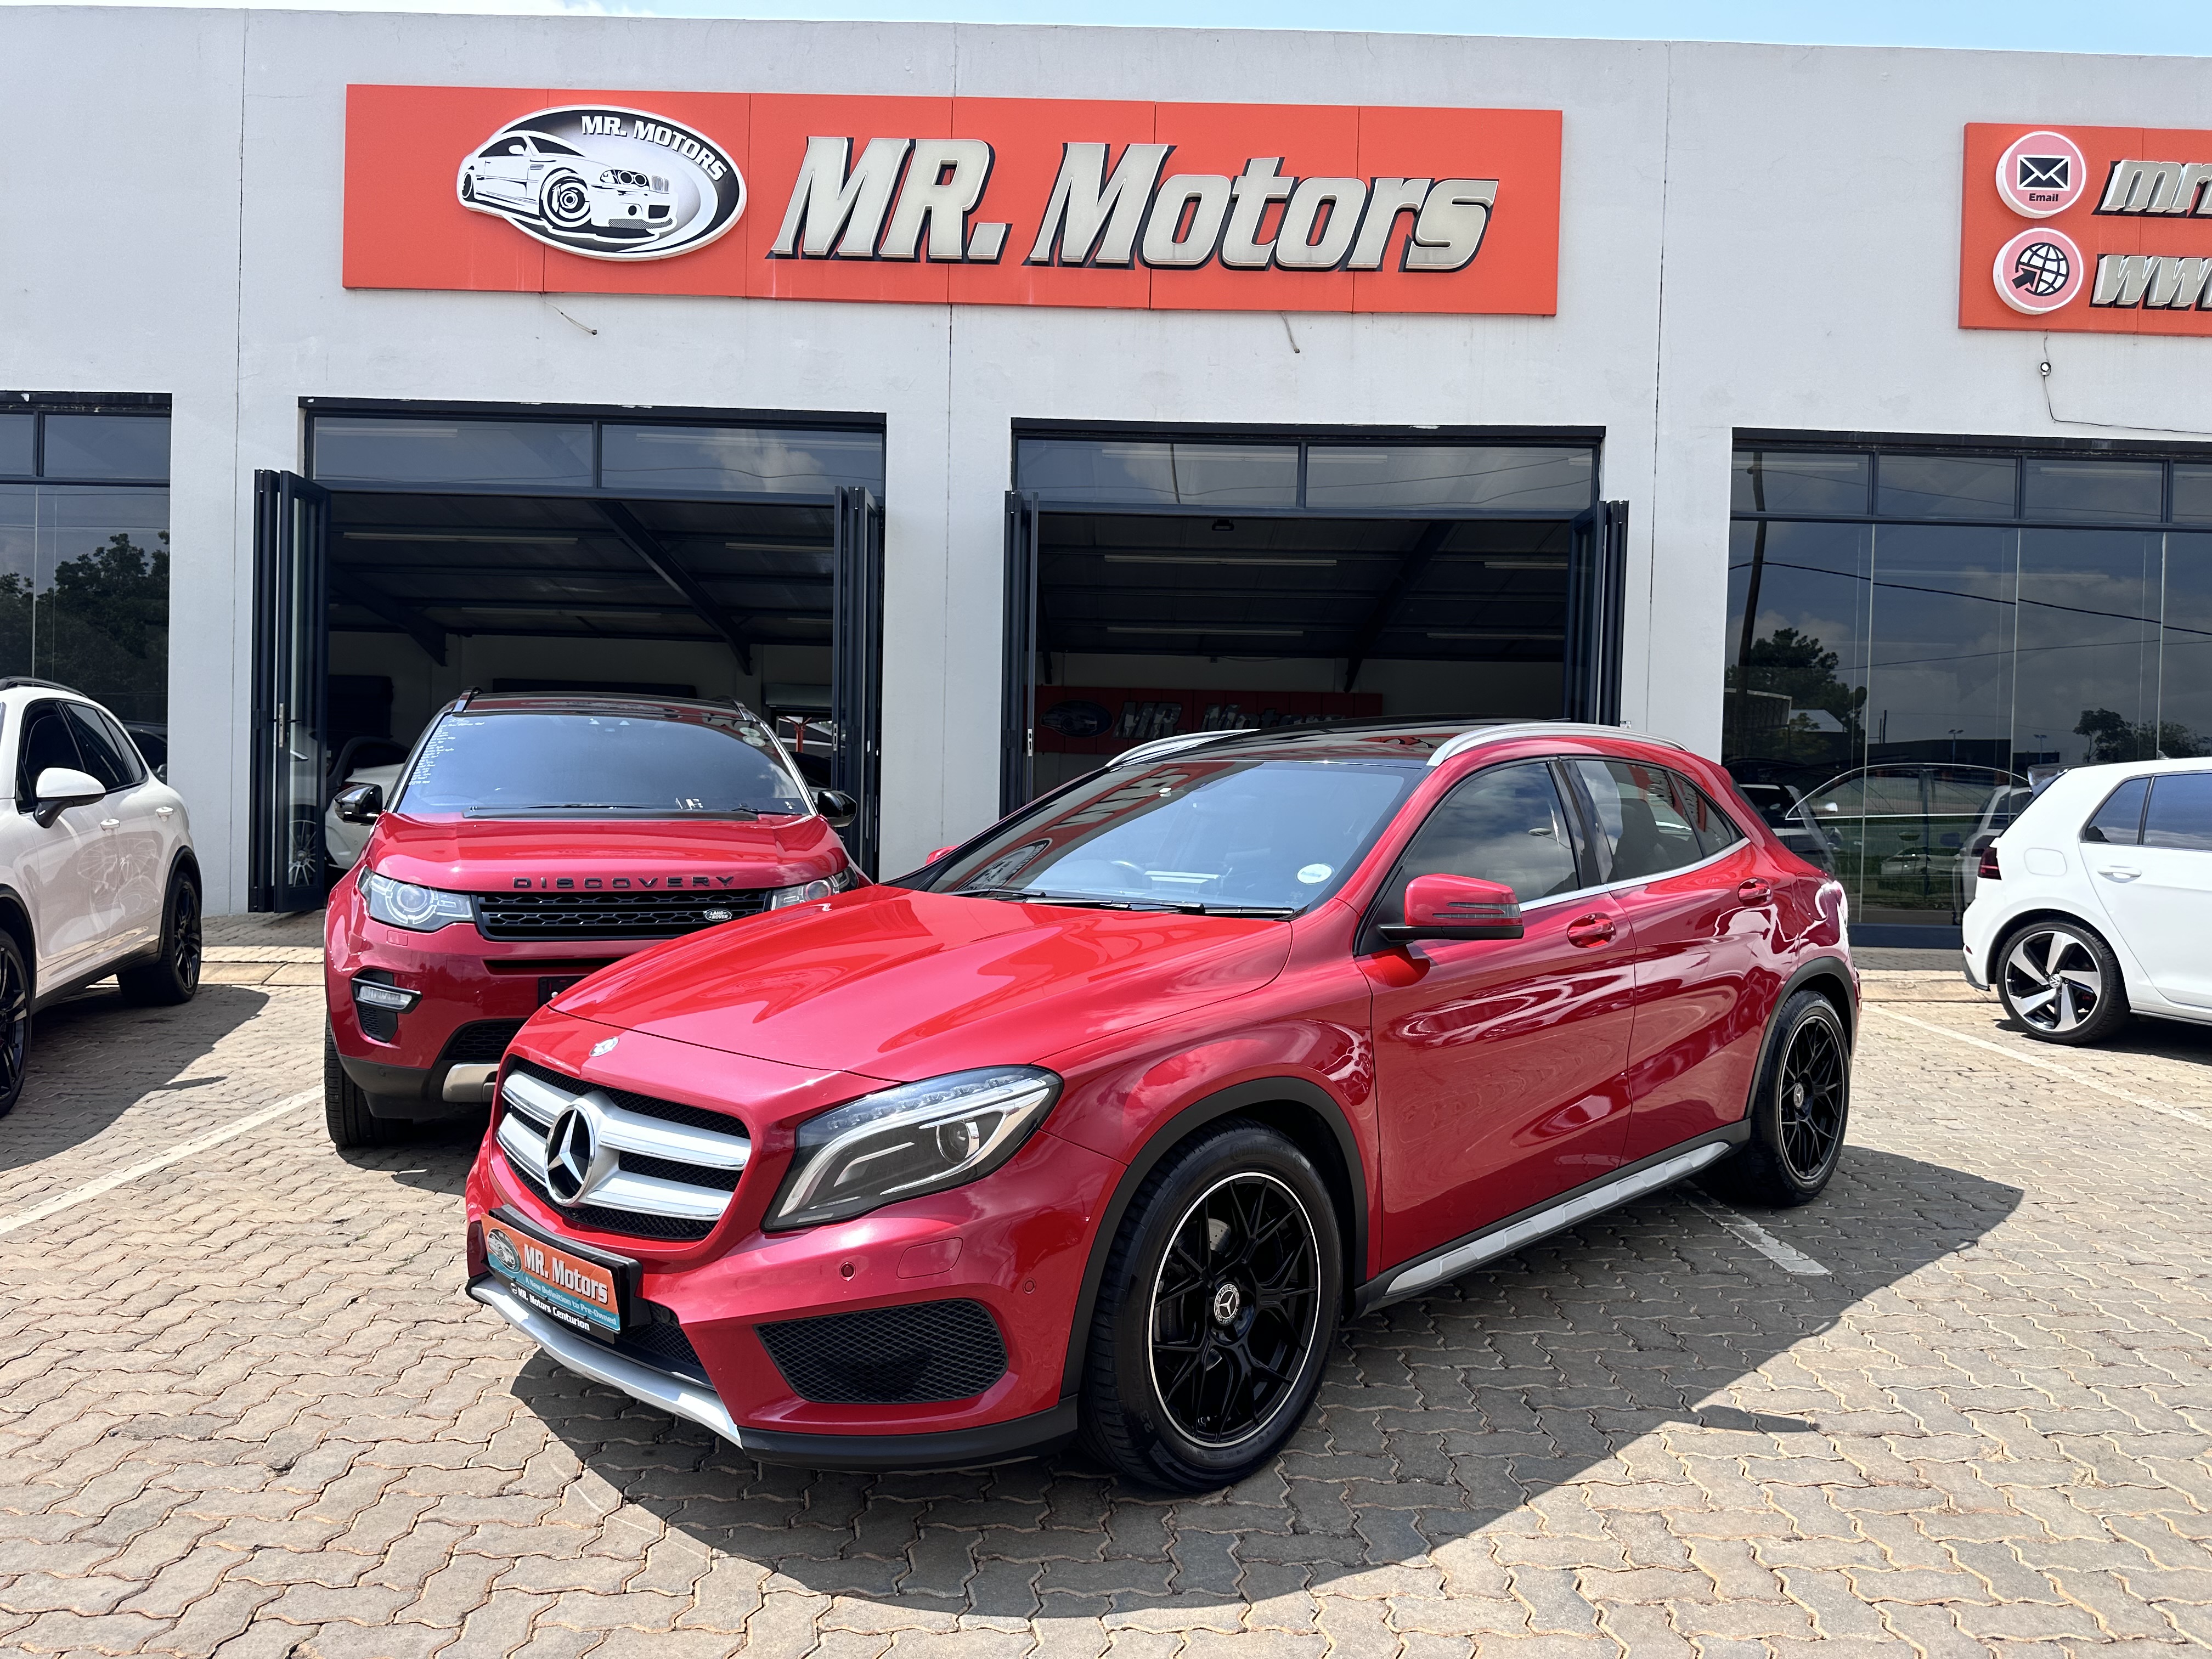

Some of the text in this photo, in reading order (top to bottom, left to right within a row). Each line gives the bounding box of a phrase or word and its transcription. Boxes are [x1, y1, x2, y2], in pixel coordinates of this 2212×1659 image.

[581, 116, 727, 180] MR. MOTORS
[767, 136, 1498, 271] MR. Motors
[2029, 193, 2058, 202] Email
[1112, 701, 1187, 740] MR.
[514, 876, 733, 888] DISCOVERY
[524, 1243, 549, 1279] MR.
[552, 1257, 608, 1305] Motors
[518, 1287, 590, 1331] MR. Motors Centurion
[525, 1276, 617, 1325] A New Definition to Pre-Owned
